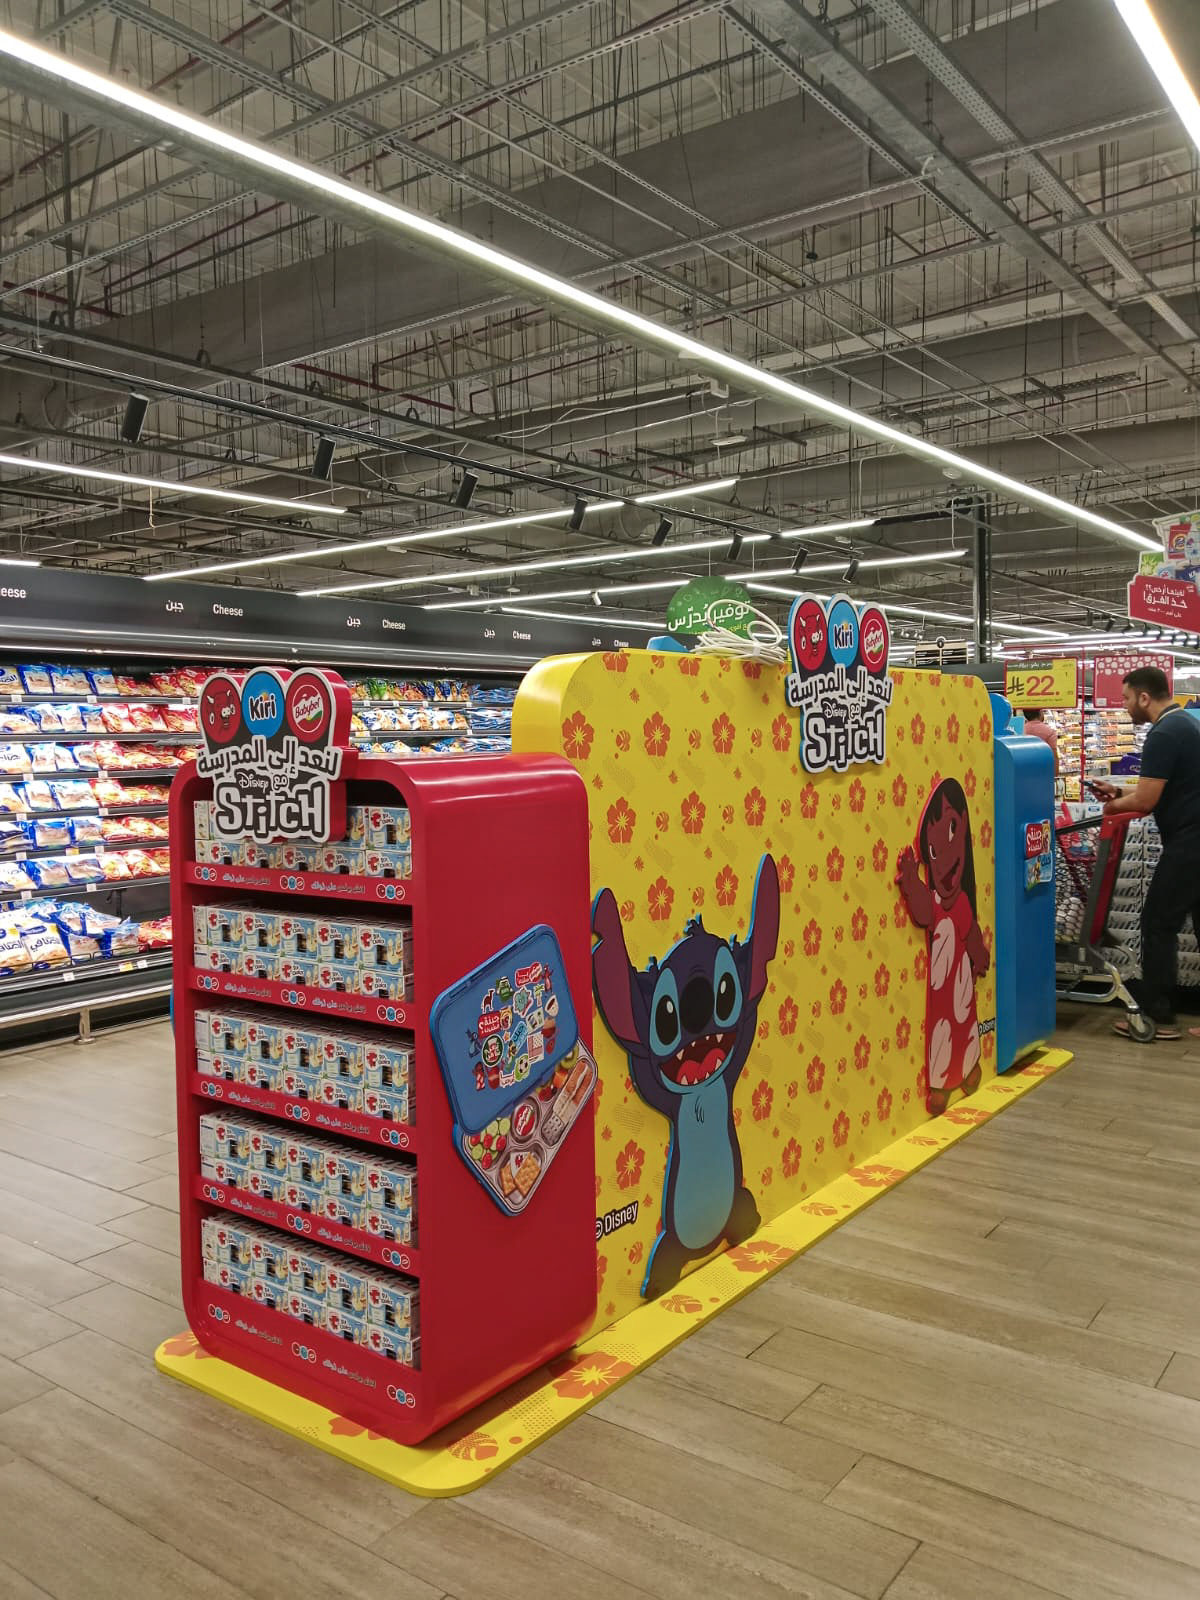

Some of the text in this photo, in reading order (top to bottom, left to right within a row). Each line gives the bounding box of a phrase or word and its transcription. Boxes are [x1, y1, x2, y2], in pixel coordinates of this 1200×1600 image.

[0, 586, 27, 599] eese
[165, 599, 184, 613] جبن
[212, 603, 244, 617] Cheese
[346, 615, 361, 628] جبن
[381, 618, 406, 631] Cheese
[512, 630, 532, 640] Cheese
[833, 622, 854, 650] Kiri
[790, 667, 844, 703] المدرسة
[846, 669, 866, 703] إلى
[248, 692, 277, 722] Kiri
[295, 696, 321, 719] Babybel
[198, 738, 265, 774] المدرسة
[267, 739, 297, 774] إلى
[272, 774, 288, 790] مع
